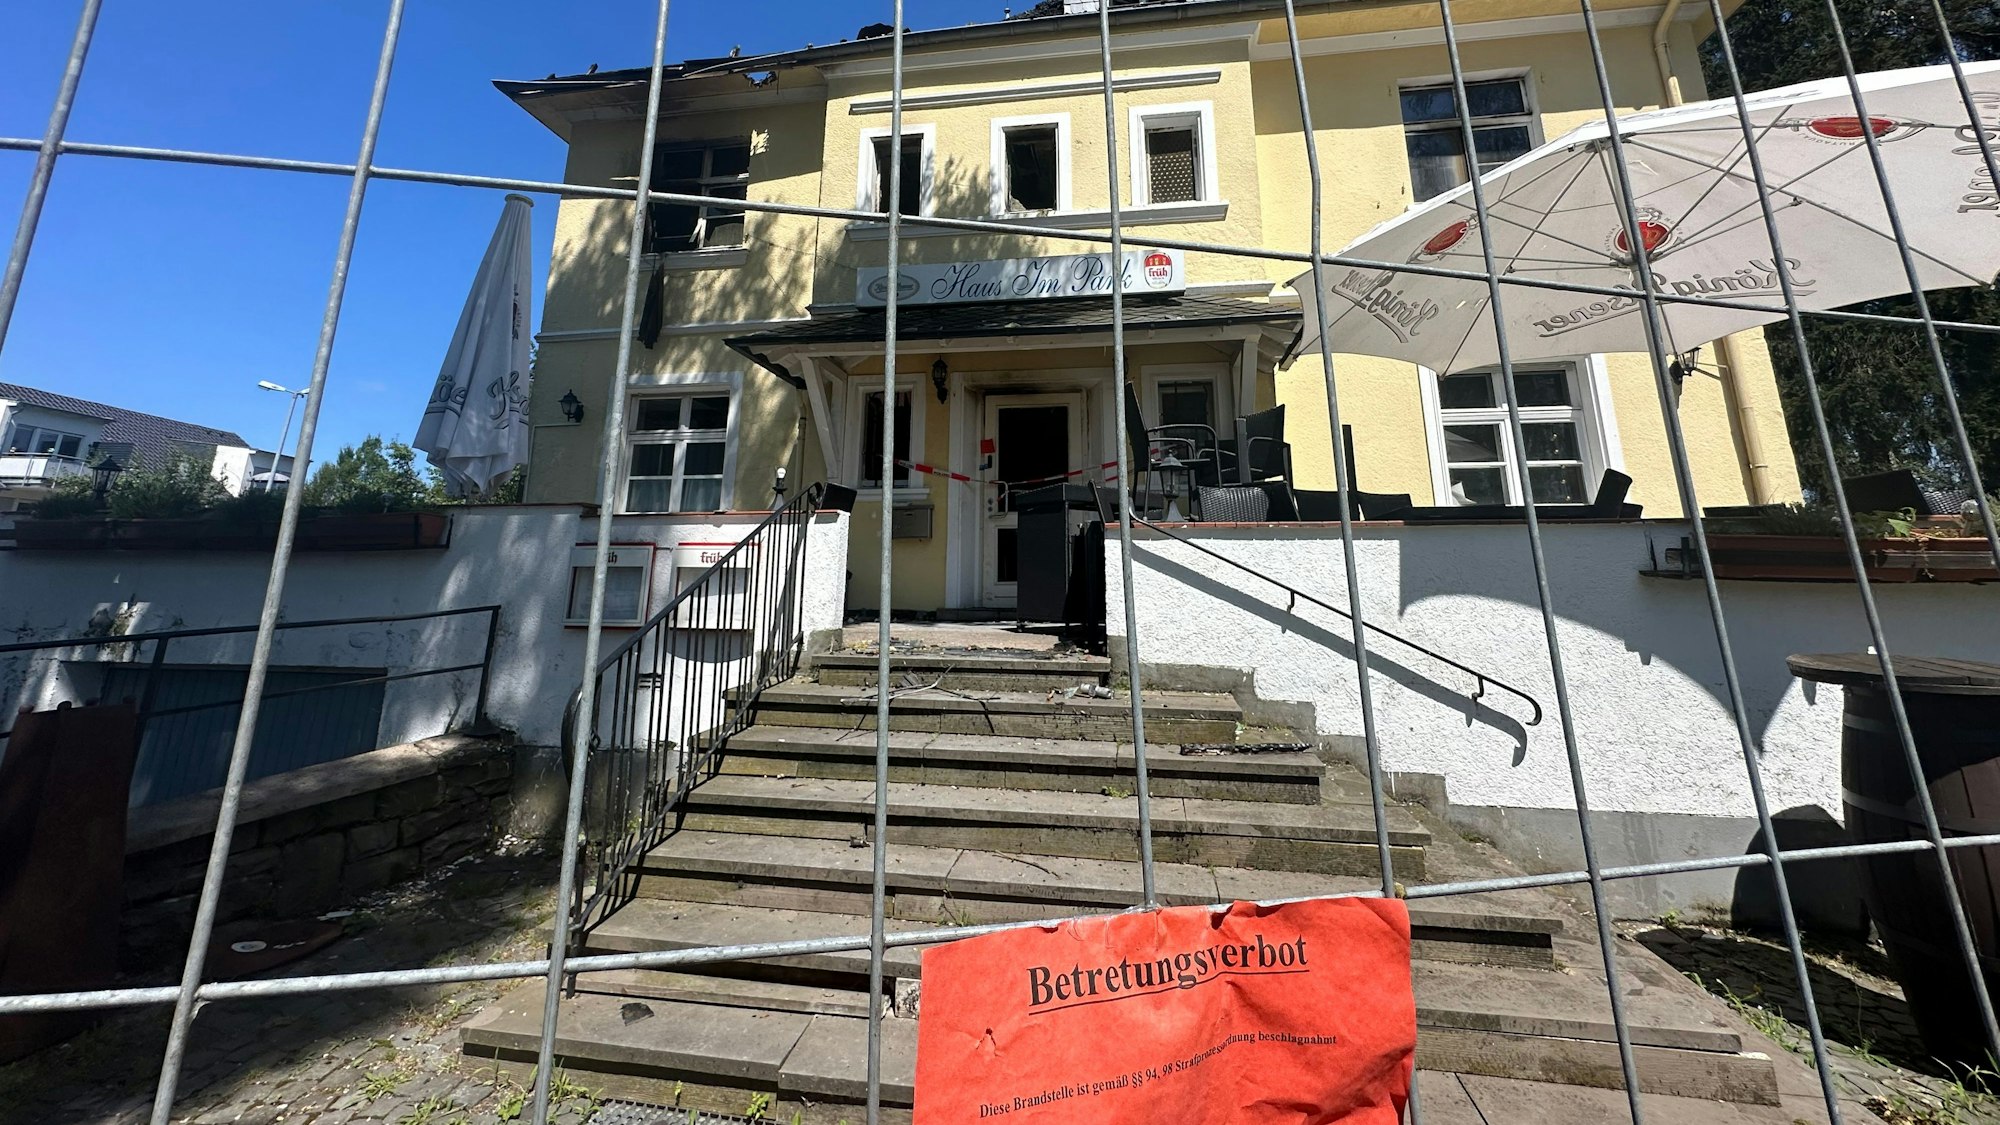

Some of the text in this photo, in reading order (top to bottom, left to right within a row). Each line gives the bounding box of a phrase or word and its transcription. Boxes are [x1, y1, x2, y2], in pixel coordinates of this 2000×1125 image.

[931, 263, 1001, 300] Haus
[1012, 259, 1061, 296] Im
[1027, 934, 1309, 1007] Betretungsverbot
[979, 1103, 1011, 1119] Diese
[1013, 1085, 1074, 1112] Brandstelle
[1077, 1083, 1090, 1097] ist
[1092, 1074, 1129, 1096] gemäß
[1132, 1071, 1143, 1089] §§
[1162, 1062, 1173, 1077] 98
[1258, 1031, 1337, 1045] beschlagnahmt
